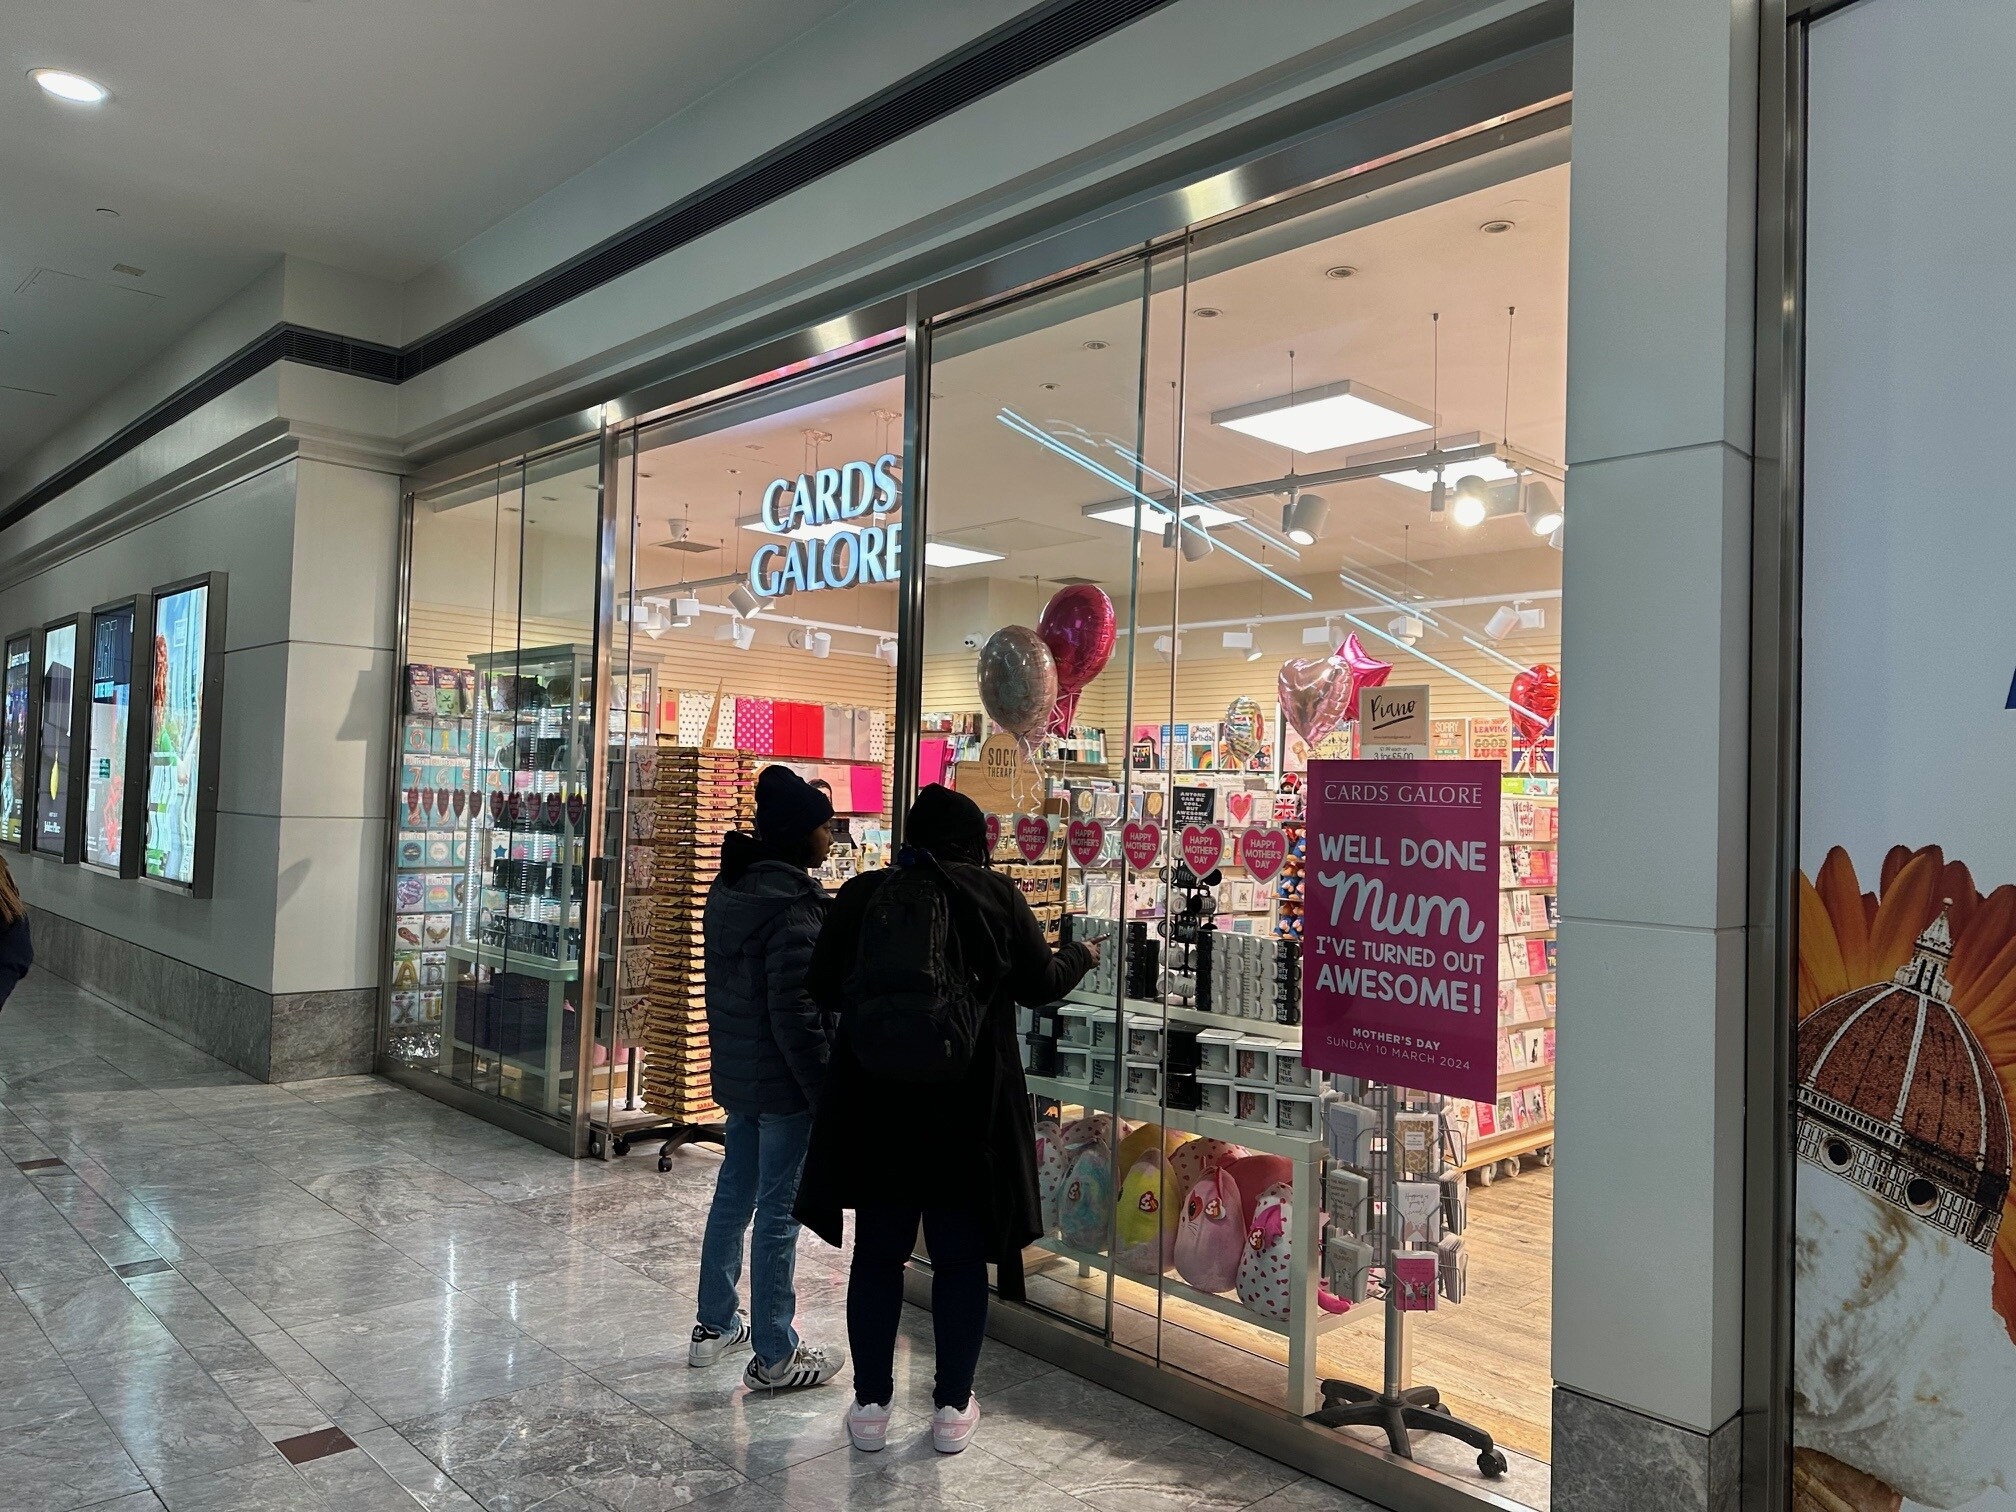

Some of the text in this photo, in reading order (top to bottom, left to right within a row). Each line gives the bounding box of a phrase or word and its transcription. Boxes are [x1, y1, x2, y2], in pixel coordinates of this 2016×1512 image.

[761, 453, 899, 533] CARDS
[751, 522, 902, 598] GALORE
[1371, 695, 1418, 721] Piano
[1474, 738, 1508, 747] GOOD
[988, 747, 1017, 768] SOCK
[1474, 749, 1507, 758] LUCK
[988, 767, 1016, 778] THERAPY
[1324, 784, 1483, 805] CARDS GALORE
[1022, 825, 1042, 834] HAPPY
[1075, 829, 1096, 839] HAPPY
[1019, 834, 1046, 844] MOTHER'S
[1129, 832, 1152, 841] HAPPY
[1189, 836, 1214, 846] HAPPY
[1025, 843, 1037, 851] DAY
[1070, 838, 1100, 847] MOTHER'S
[1125, 841, 1157, 851] MOTHER'S
[1250, 838, 1276, 850] HAPPY
[1078, 847, 1091, 855] DAY
[1133, 851, 1147, 860] DAY
[1184, 845, 1219, 856] MOTHER'S
[1245, 849, 1282, 860] MOTHER'S
[1318, 833, 1487, 872] WELL DONE
[1193, 855, 1208, 865] DAY
[1255, 860, 1271, 869] DAY
[1317, 870, 1486, 944] Mum
[1316, 935, 1485, 975] I'VE TURNED OUT
[1315, 963, 1481, 1014] AWESOME!
[1352, 1027, 1441, 1051] MOTHER'S DAY
[1326, 1035, 1471, 1071] SUNDAY 10 MARCH 2024
[863, 1424, 880, 1434] NIKE
[940, 1427, 956, 1436] NIKE
